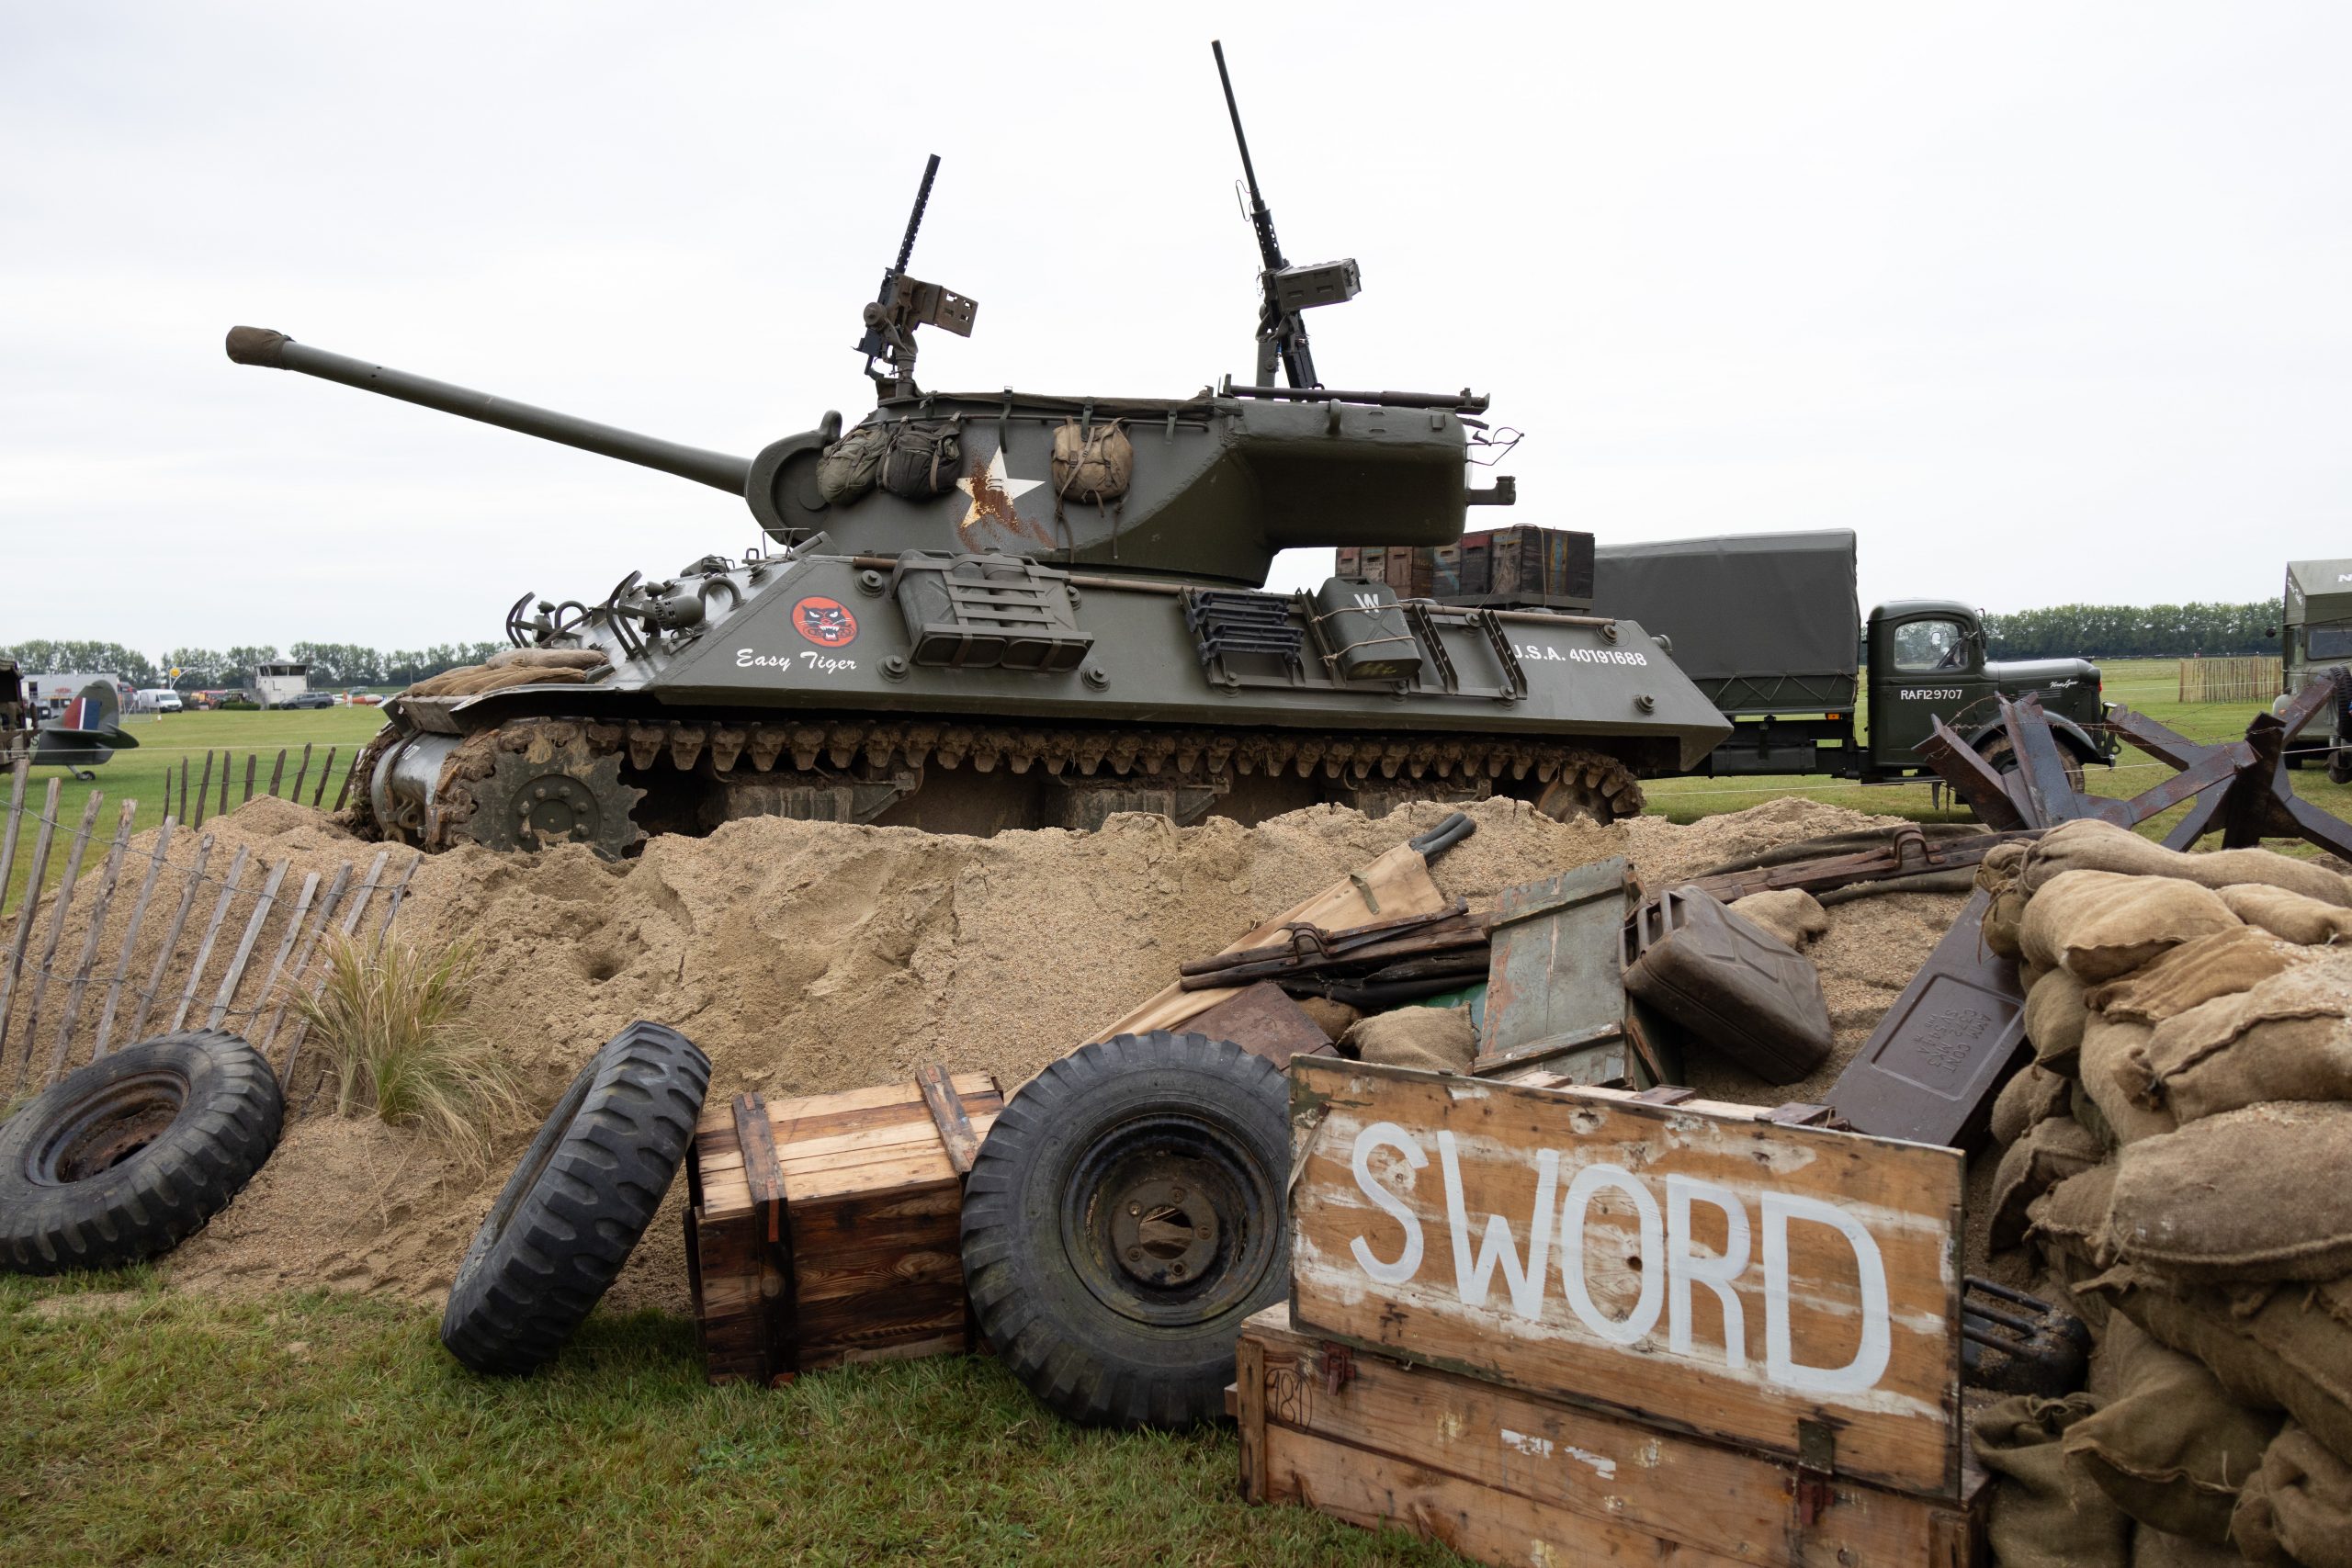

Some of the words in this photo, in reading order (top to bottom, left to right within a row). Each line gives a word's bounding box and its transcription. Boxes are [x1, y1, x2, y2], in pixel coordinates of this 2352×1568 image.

[736, 648, 791, 671] Easy
[799, 650, 857, 674] Tiger
[1569, 649, 1647, 666] 40191688
[1941, 1042, 1972, 1073] CONT
[1349, 1122, 1892, 1395] SWORD
